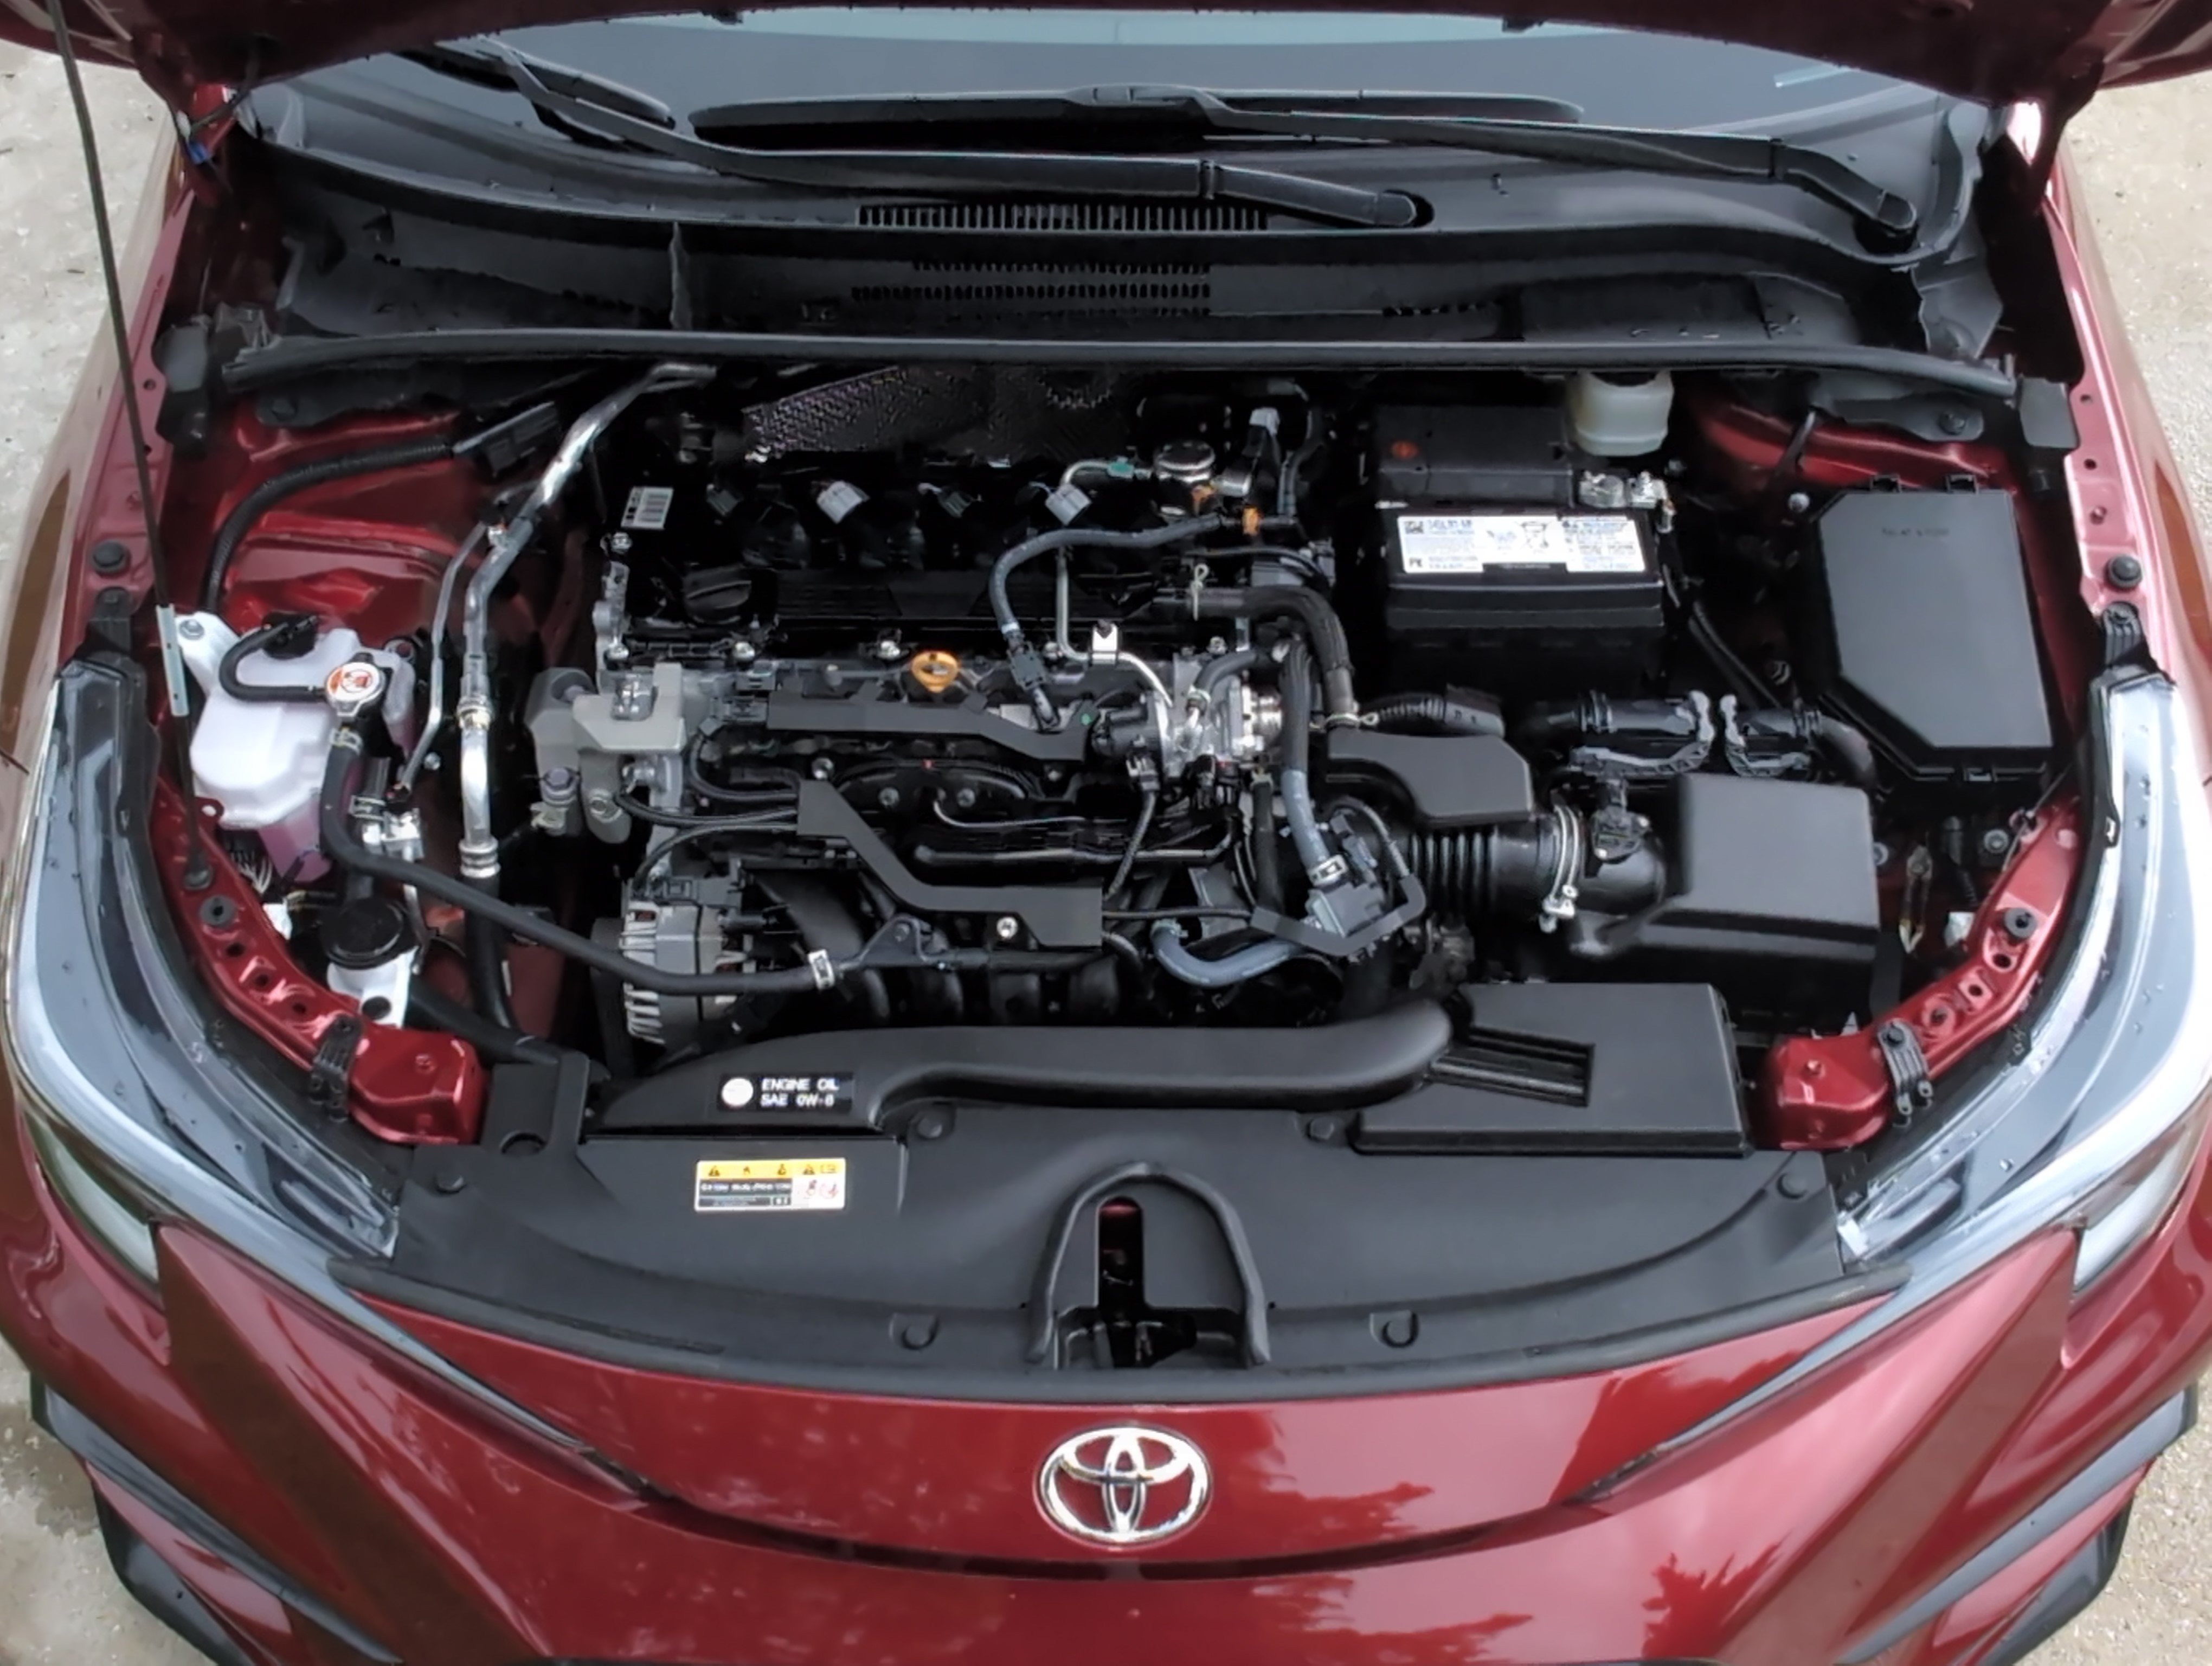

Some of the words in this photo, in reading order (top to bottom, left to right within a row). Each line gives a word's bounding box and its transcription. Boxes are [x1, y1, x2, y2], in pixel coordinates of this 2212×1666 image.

[762, 1077, 810, 1091] ENGINE
[817, 1077, 839, 1091] OIL
[760, 1093, 788, 1107] SAE
